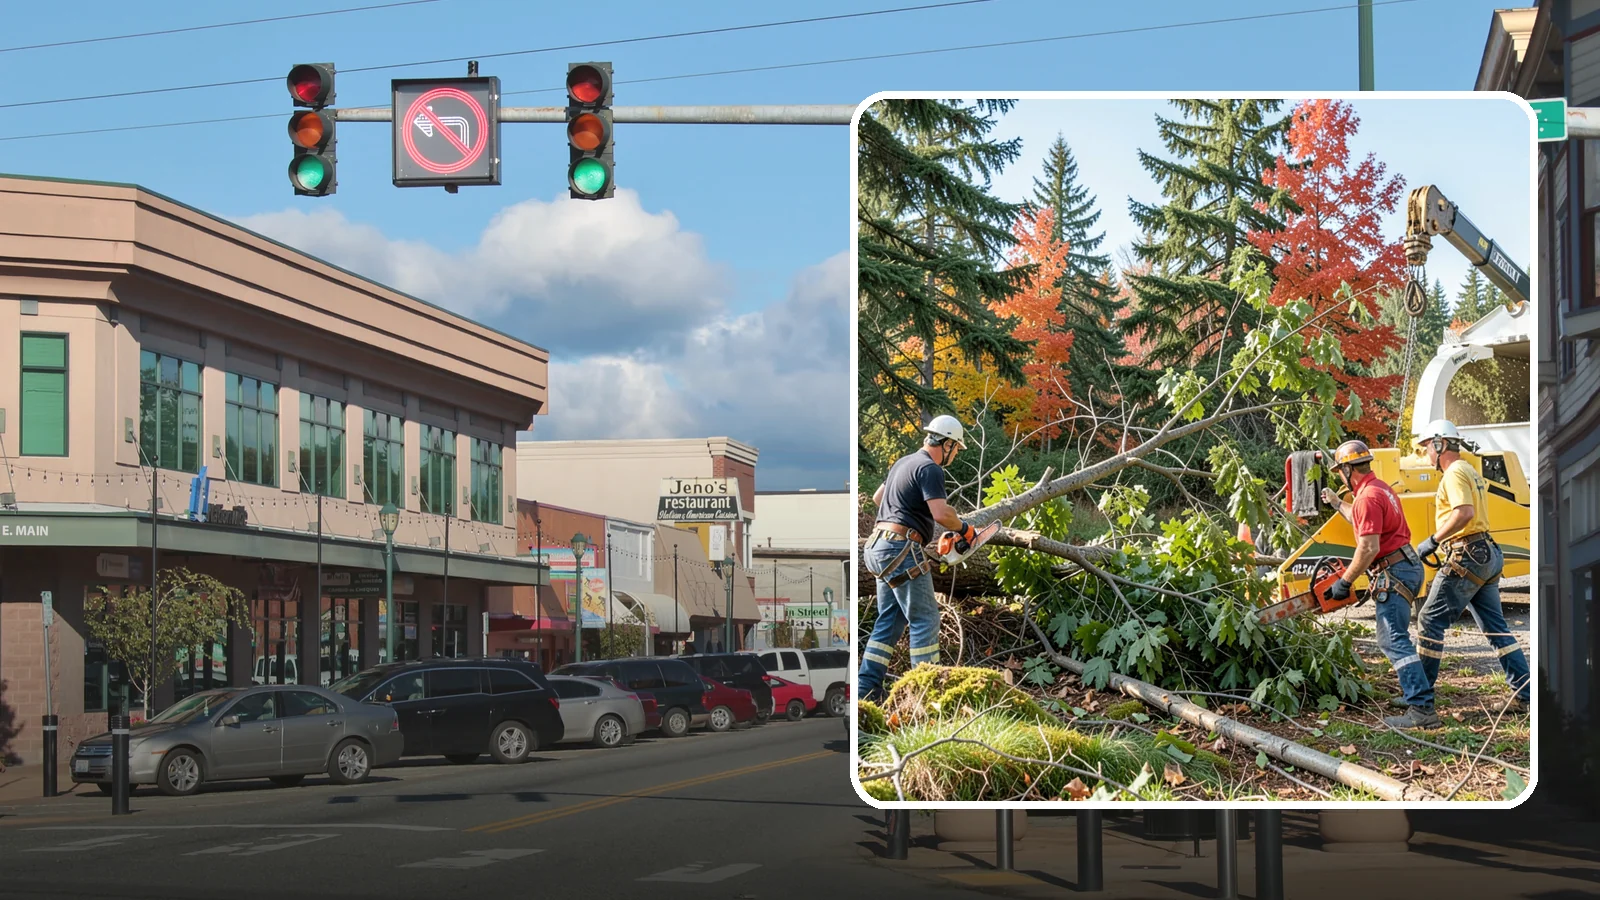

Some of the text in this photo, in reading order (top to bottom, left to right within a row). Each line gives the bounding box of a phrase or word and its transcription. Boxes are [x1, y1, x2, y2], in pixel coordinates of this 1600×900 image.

[670, 480, 728, 494] Jeno's
[665, 496, 731, 509] restaurant
[685, 509, 715, 519] American
[714, 509, 738, 519] Cuisine
[2, 525, 49, 536] E. MAIN
[797, 607, 828, 617] Street
[791, 619, 824, 627] lass
